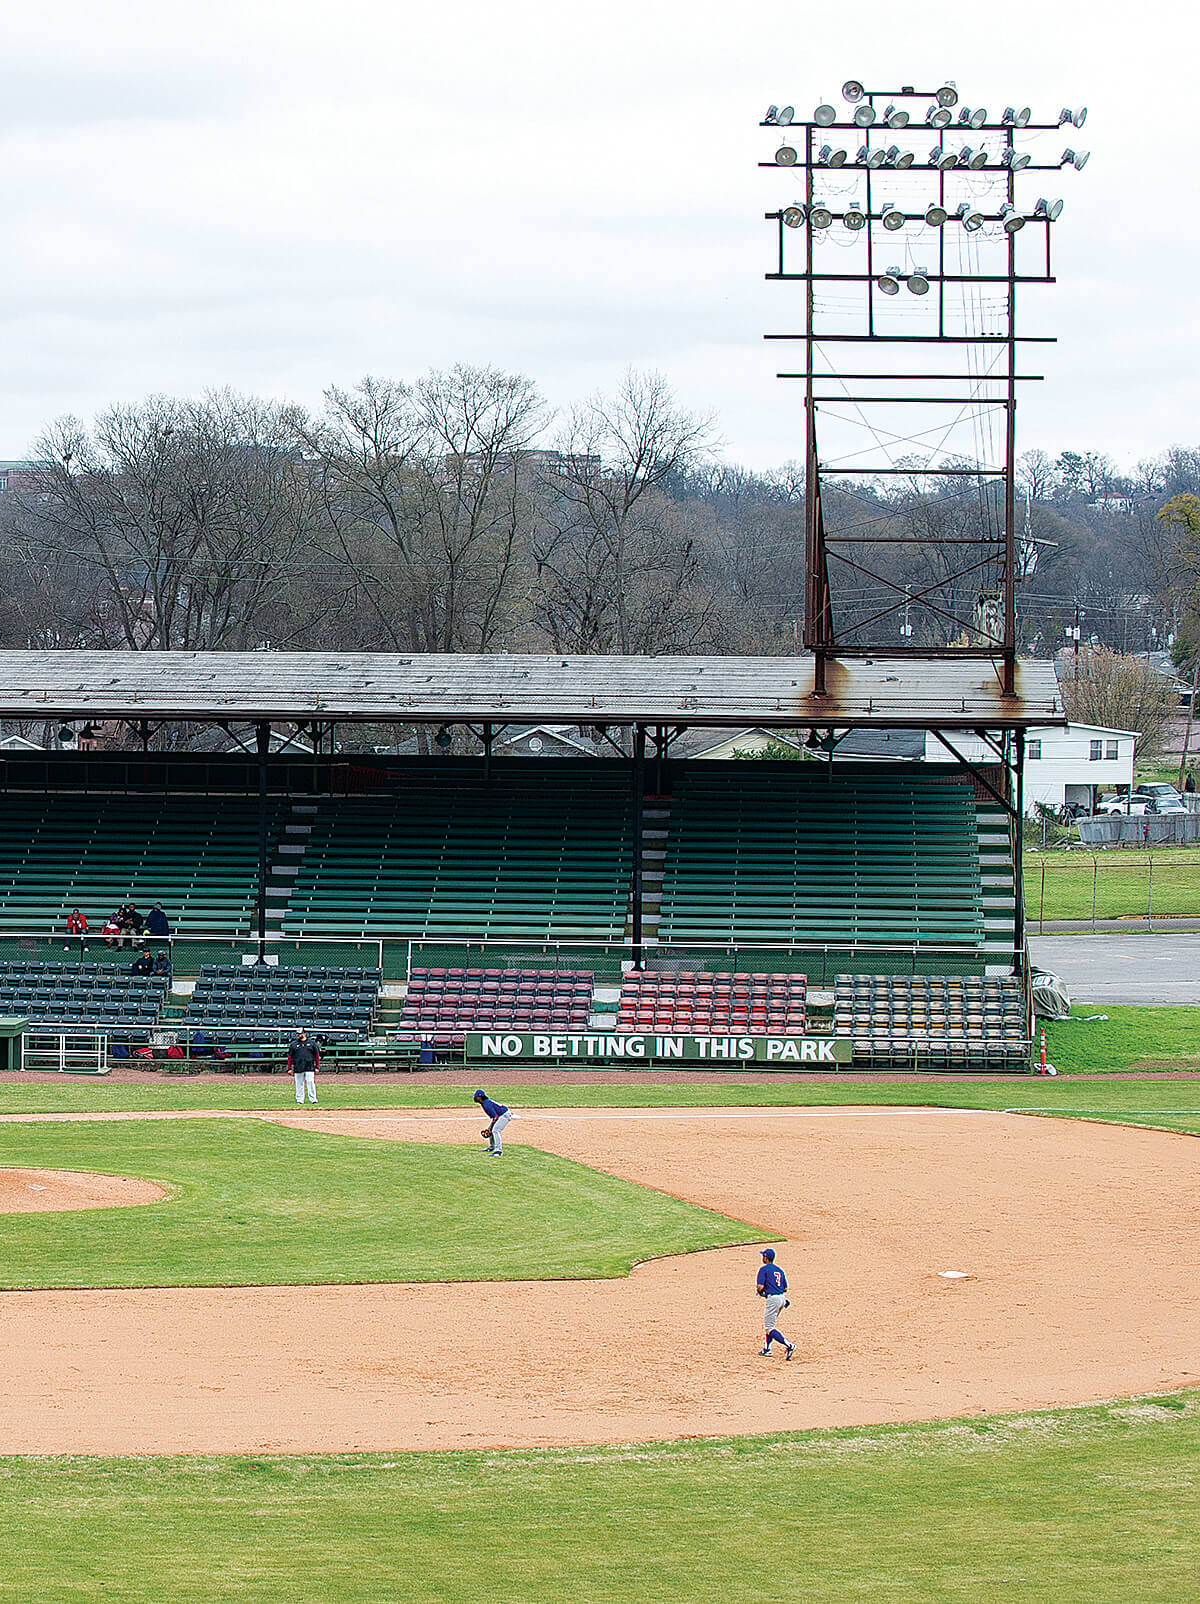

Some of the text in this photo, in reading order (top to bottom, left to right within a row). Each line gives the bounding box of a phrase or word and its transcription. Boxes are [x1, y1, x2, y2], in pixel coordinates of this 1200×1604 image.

[482, 1035, 835, 1061] NO BETTING IN THIS PARK
